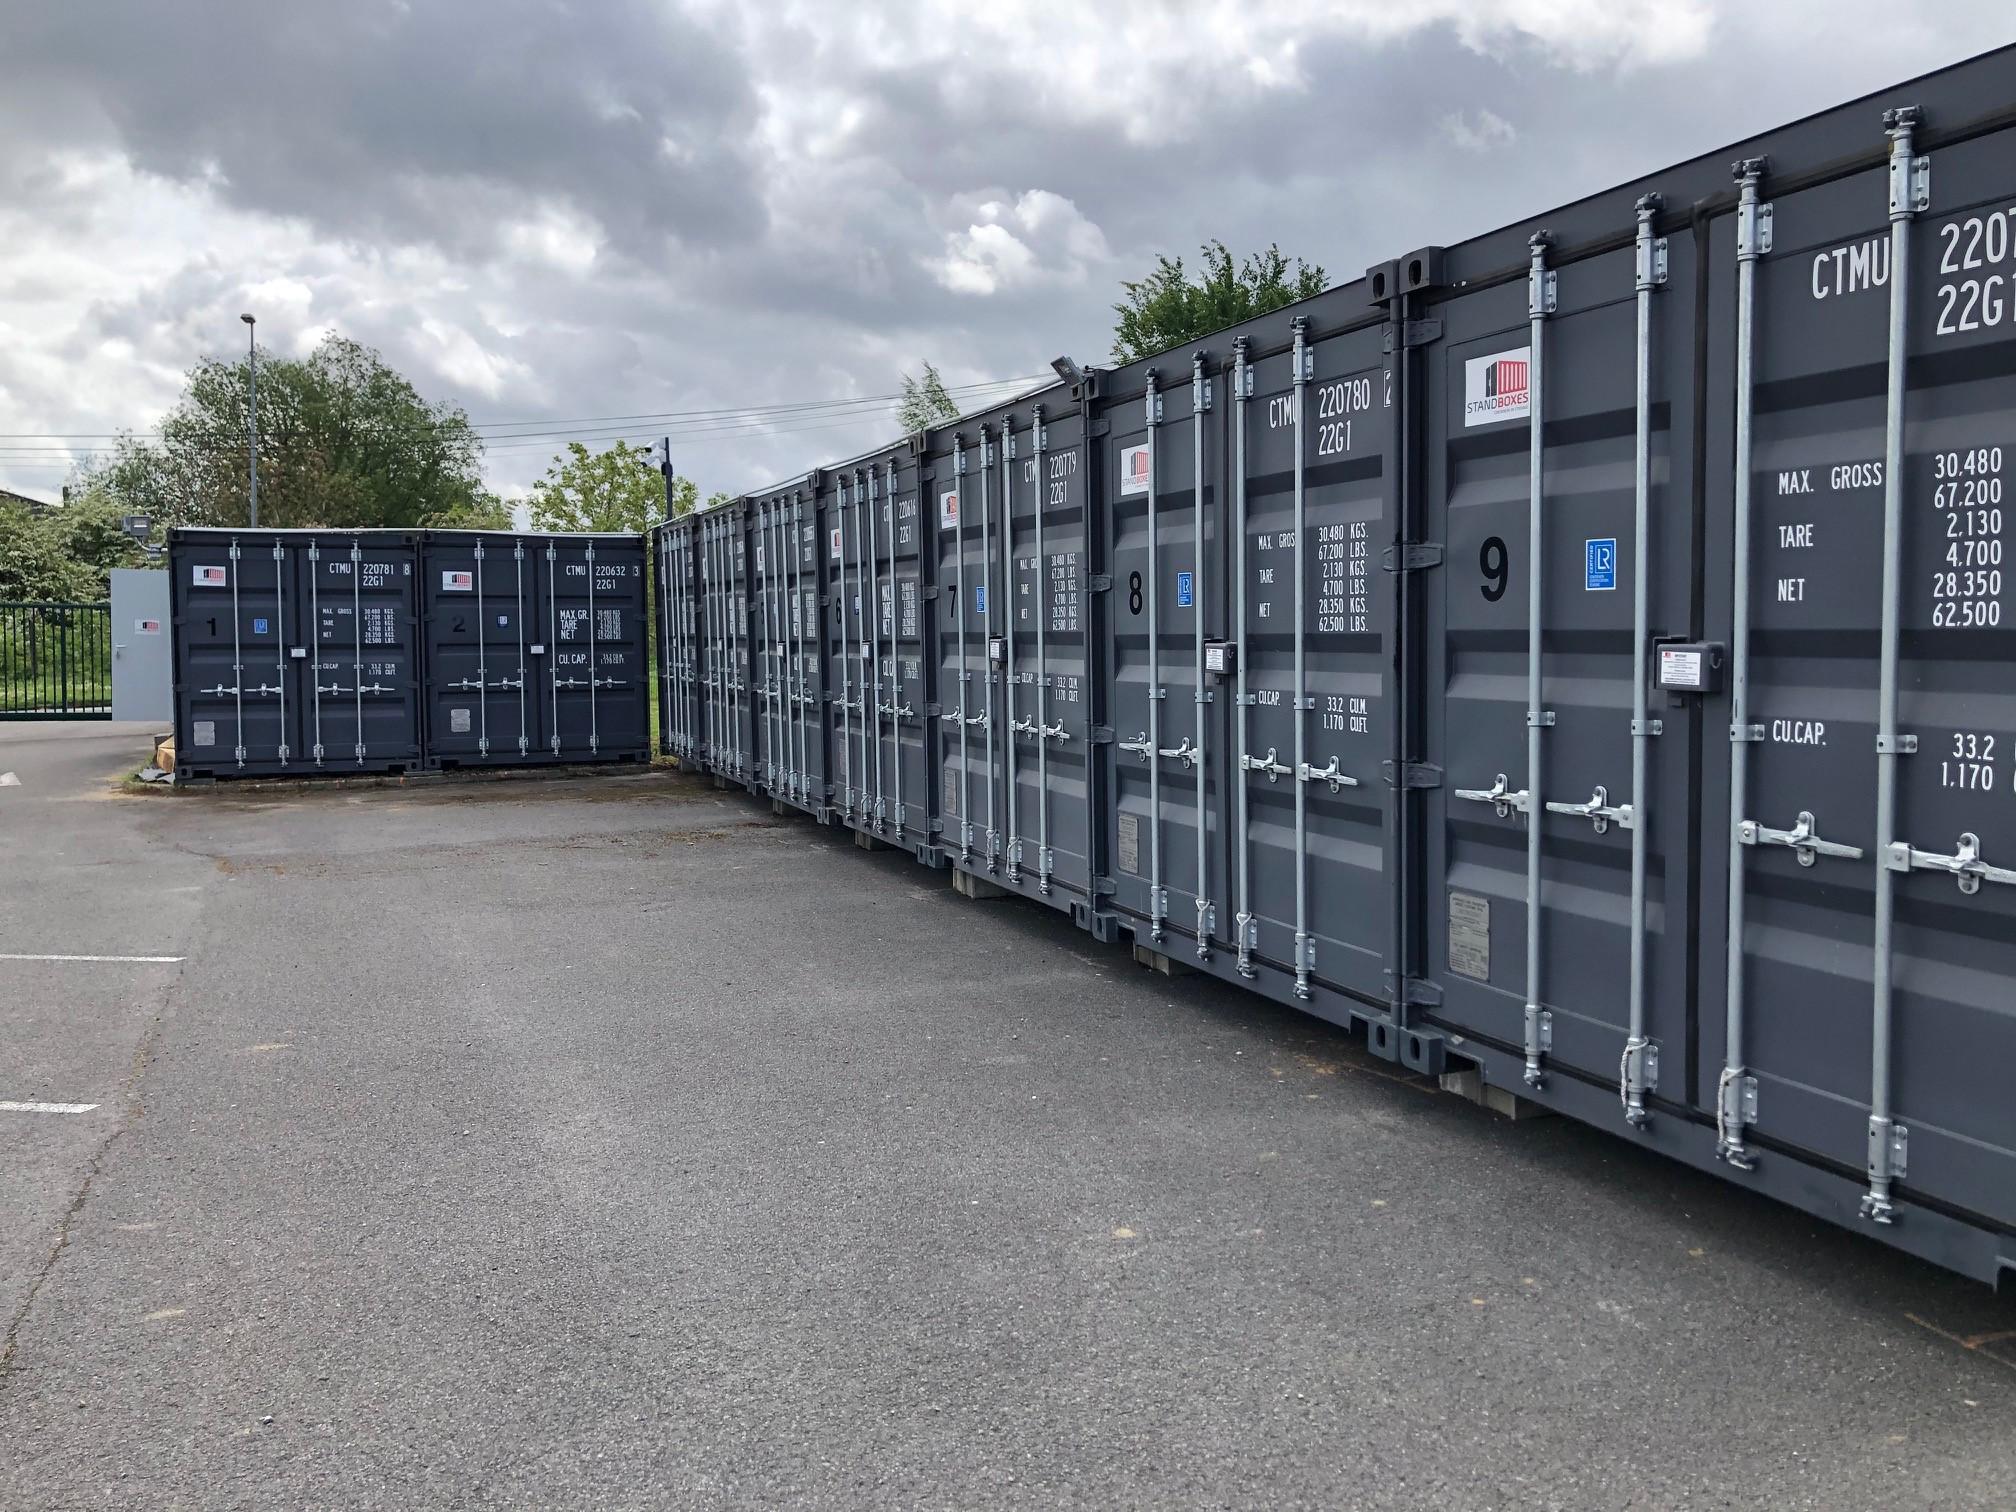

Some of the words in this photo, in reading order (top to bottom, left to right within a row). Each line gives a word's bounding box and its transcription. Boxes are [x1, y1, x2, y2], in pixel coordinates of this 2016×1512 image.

[1812, 236, 1889, 299] CTMU
[1318, 378, 1371, 419] 220780
[1318, 420, 1351, 456] 22G1
[1050, 450, 1077, 479] 220779
[1778, 470, 1814, 495] MAX.
[1831, 462, 1882, 490] GROSS
[1050, 480, 1067, 505] 22G1
[1279, 532, 1295, 548] GROS
[1350, 522, 1369, 539] KGS.
[1779, 524, 1814, 548] TARE
[1350, 541, 1369, 558] LBS.
[329, 563, 351, 574] CTMU
[363, 563, 394, 575] 220781
[404, 563, 410, 575] 8
[566, 565, 586, 576] CTMU
[595, 565, 626, 577] 220632
[1259, 568, 1274, 584] TARE
[1349, 559, 1368, 577] KGS.
[1479, 536, 1509, 602] 9
[362, 575, 384, 587] 22G1
[596, 579, 616, 590] 22G1
[1349, 578, 1368, 595] LBS.
[1777, 578, 1805, 601] NET
[948, 585, 957, 618] 7
[1129, 570, 1143, 616] 8
[1258, 602, 1270, 617] NET
[1349, 597, 1369, 613] KGS.
[206, 617, 216, 636] 1
[452, 616, 466, 632] 2
[560, 619, 578, 630] TARE
[560, 629, 575, 640] NET
[1350, 615, 1369, 632] LBS.
[1327, 696, 1343, 713] 33.2
[1952, 733, 1994, 761] 33.2
